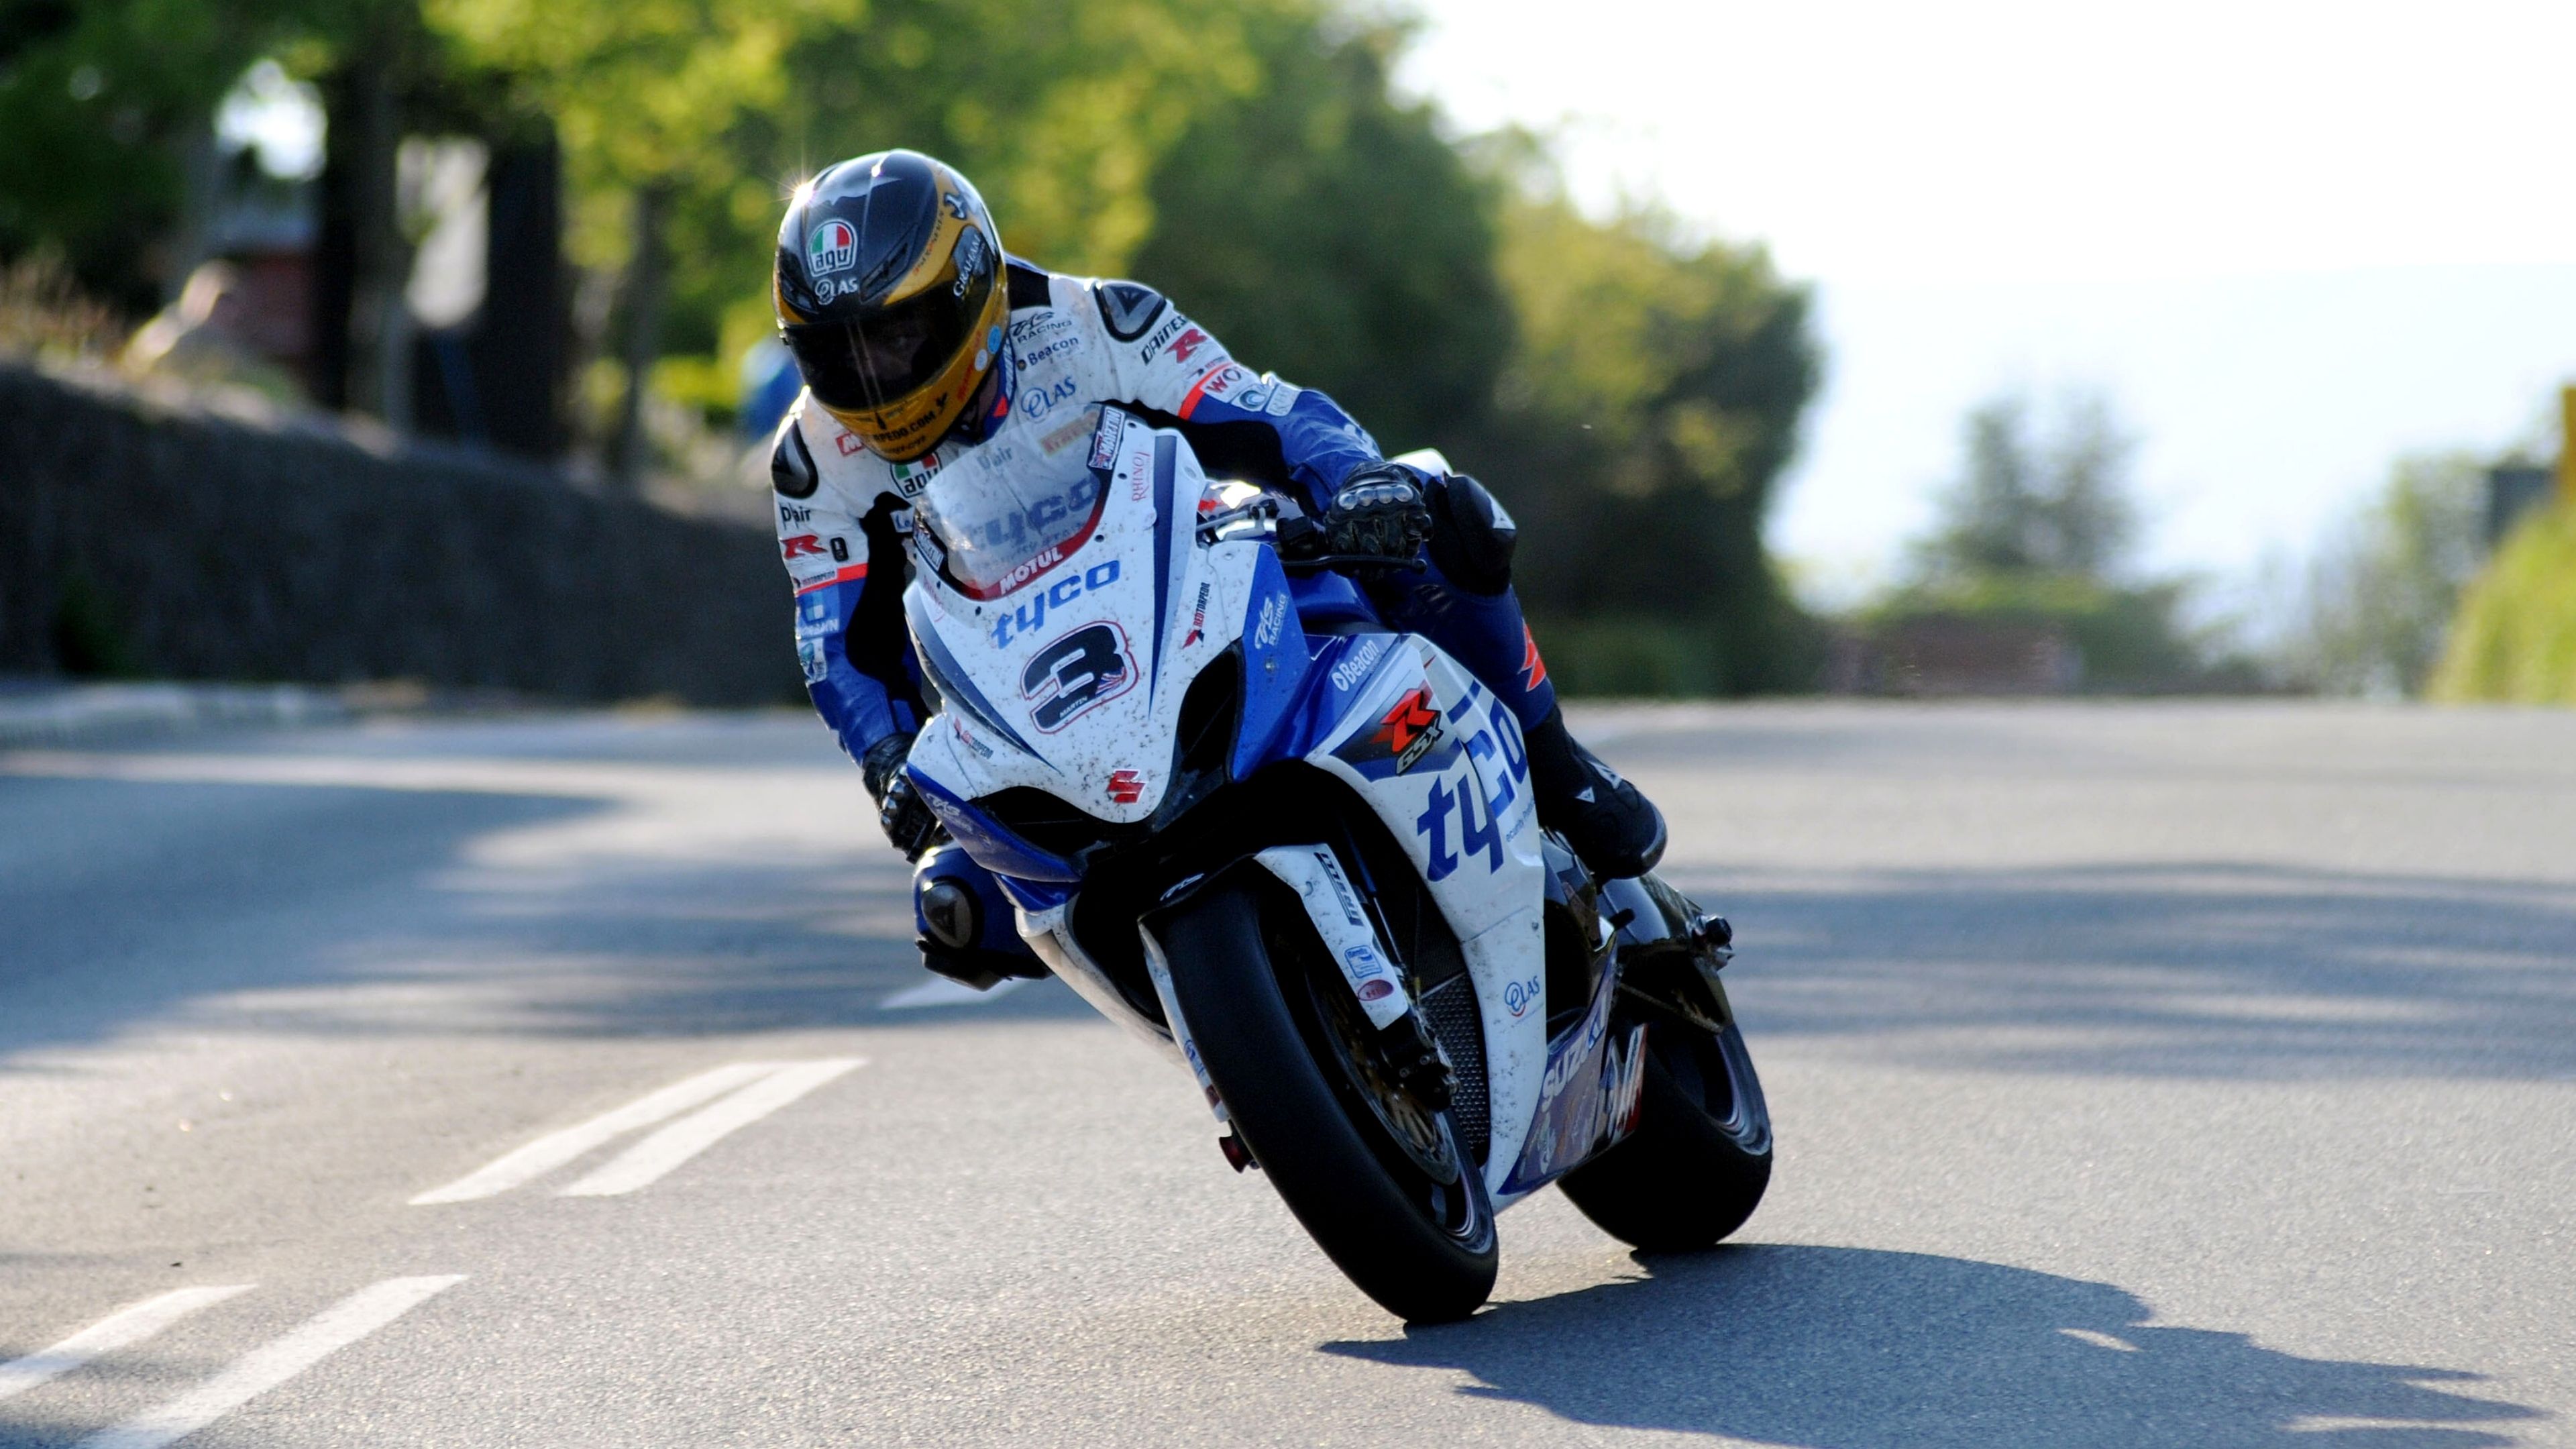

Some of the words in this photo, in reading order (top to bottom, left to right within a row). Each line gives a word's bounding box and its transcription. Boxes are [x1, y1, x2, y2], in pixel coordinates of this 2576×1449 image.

[953, 235, 981, 297] GRAHAM
[1017, 320, 1072, 344] RACING
[1027, 336, 1079, 366] Beacon
[1099, 409, 1122, 455] MARTIN
[999, 547, 1063, 595] MOTUL
[991, 559, 1120, 649] tyco
[1269, 594, 1287, 646] RACING
[1022, 622, 1134, 733] 3
[1339, 640, 1379, 684] Beacon
[1059, 696, 1088, 718] MARTIN
[1396, 718, 1440, 774] GSX
[1417, 698, 1528, 882] tyco
